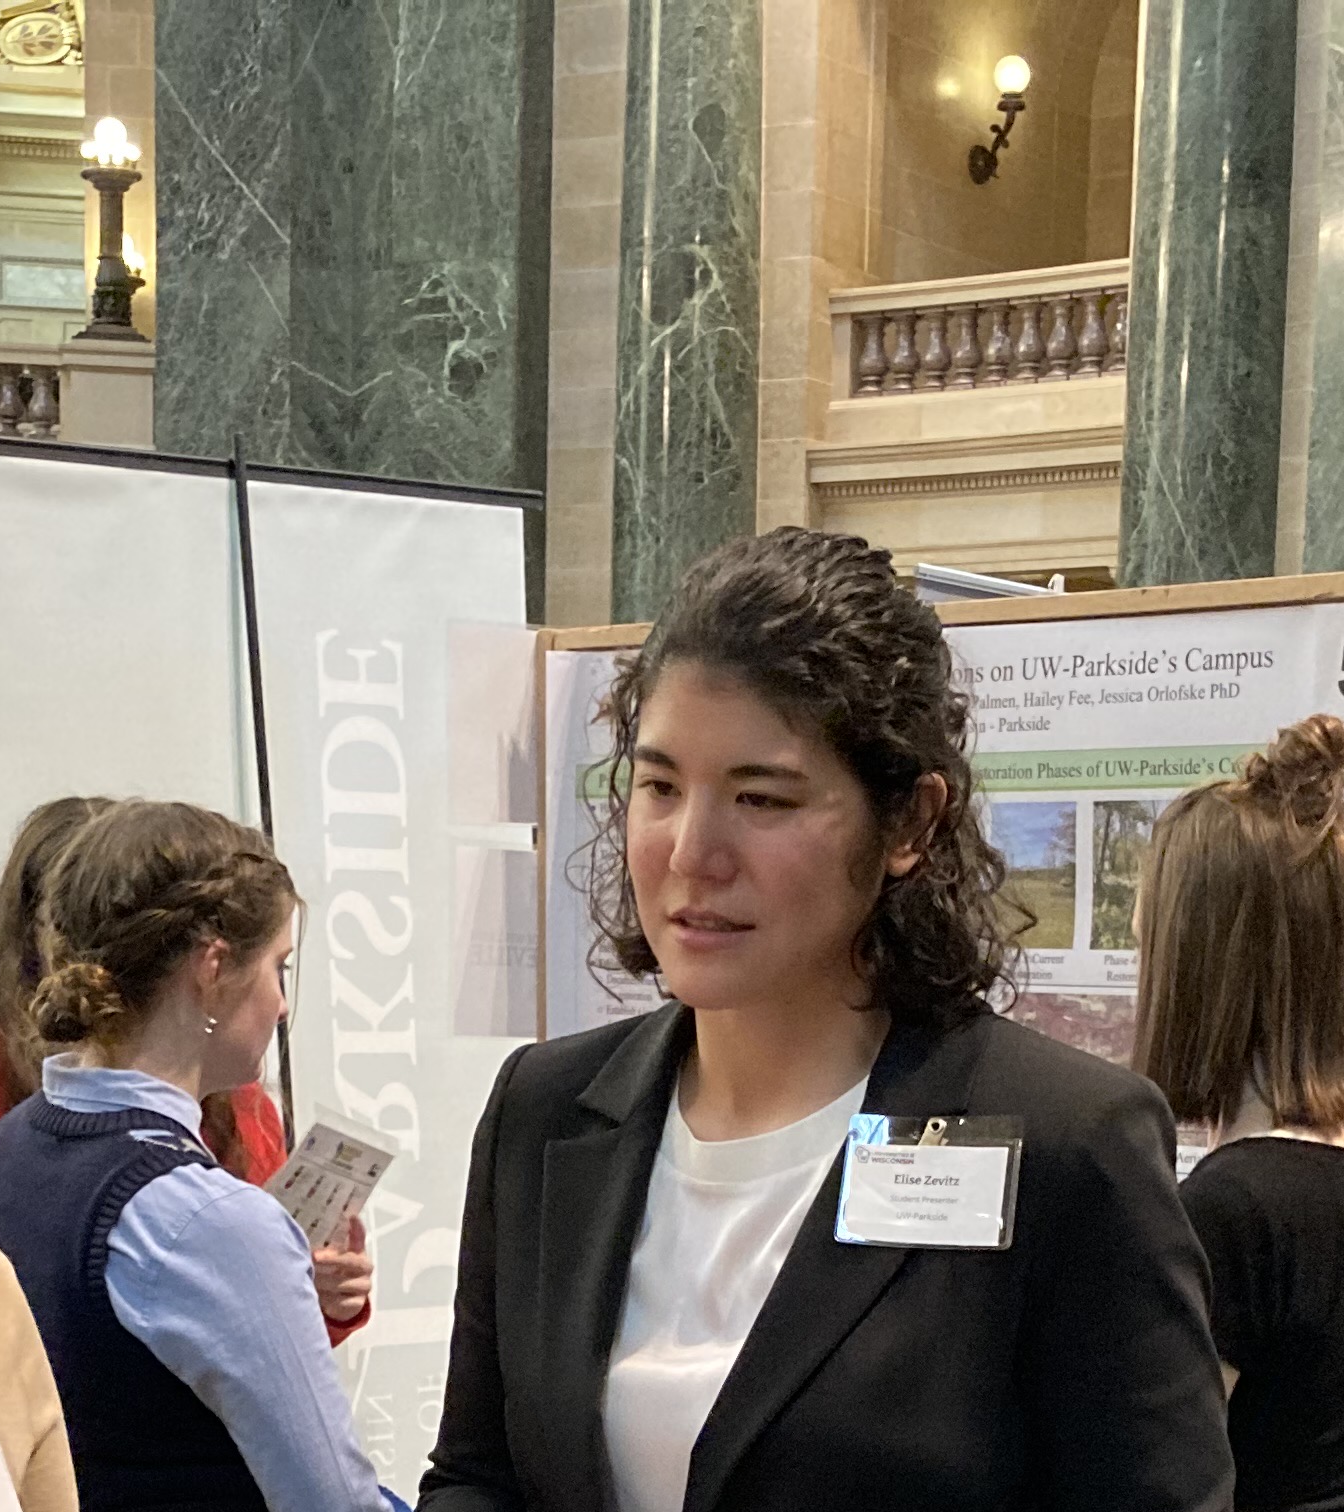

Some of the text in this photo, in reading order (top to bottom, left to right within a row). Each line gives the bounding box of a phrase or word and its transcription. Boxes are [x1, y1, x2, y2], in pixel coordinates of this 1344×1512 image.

[990, 665, 1014, 683] on
[1022, 650, 1177, 681] UW-Parkside’s
[1184, 647, 1274, 677] Campus
[1023, 691, 1065, 711] Hailey
[1068, 689, 1095, 706] Fee,
[1097, 688, 1144, 705] Jessica
[1147, 684, 1206, 702] Orlofske
[1209, 681, 1241, 700] PhD
[998, 715, 1051, 733] Parkside
[1037, 762, 1083, 780] Phases
[1086, 760, 1103, 778] of
[1105, 758, 1215, 778] UW-Parkside’s
[894, 1173, 960, 1187] Elise Zevitz
